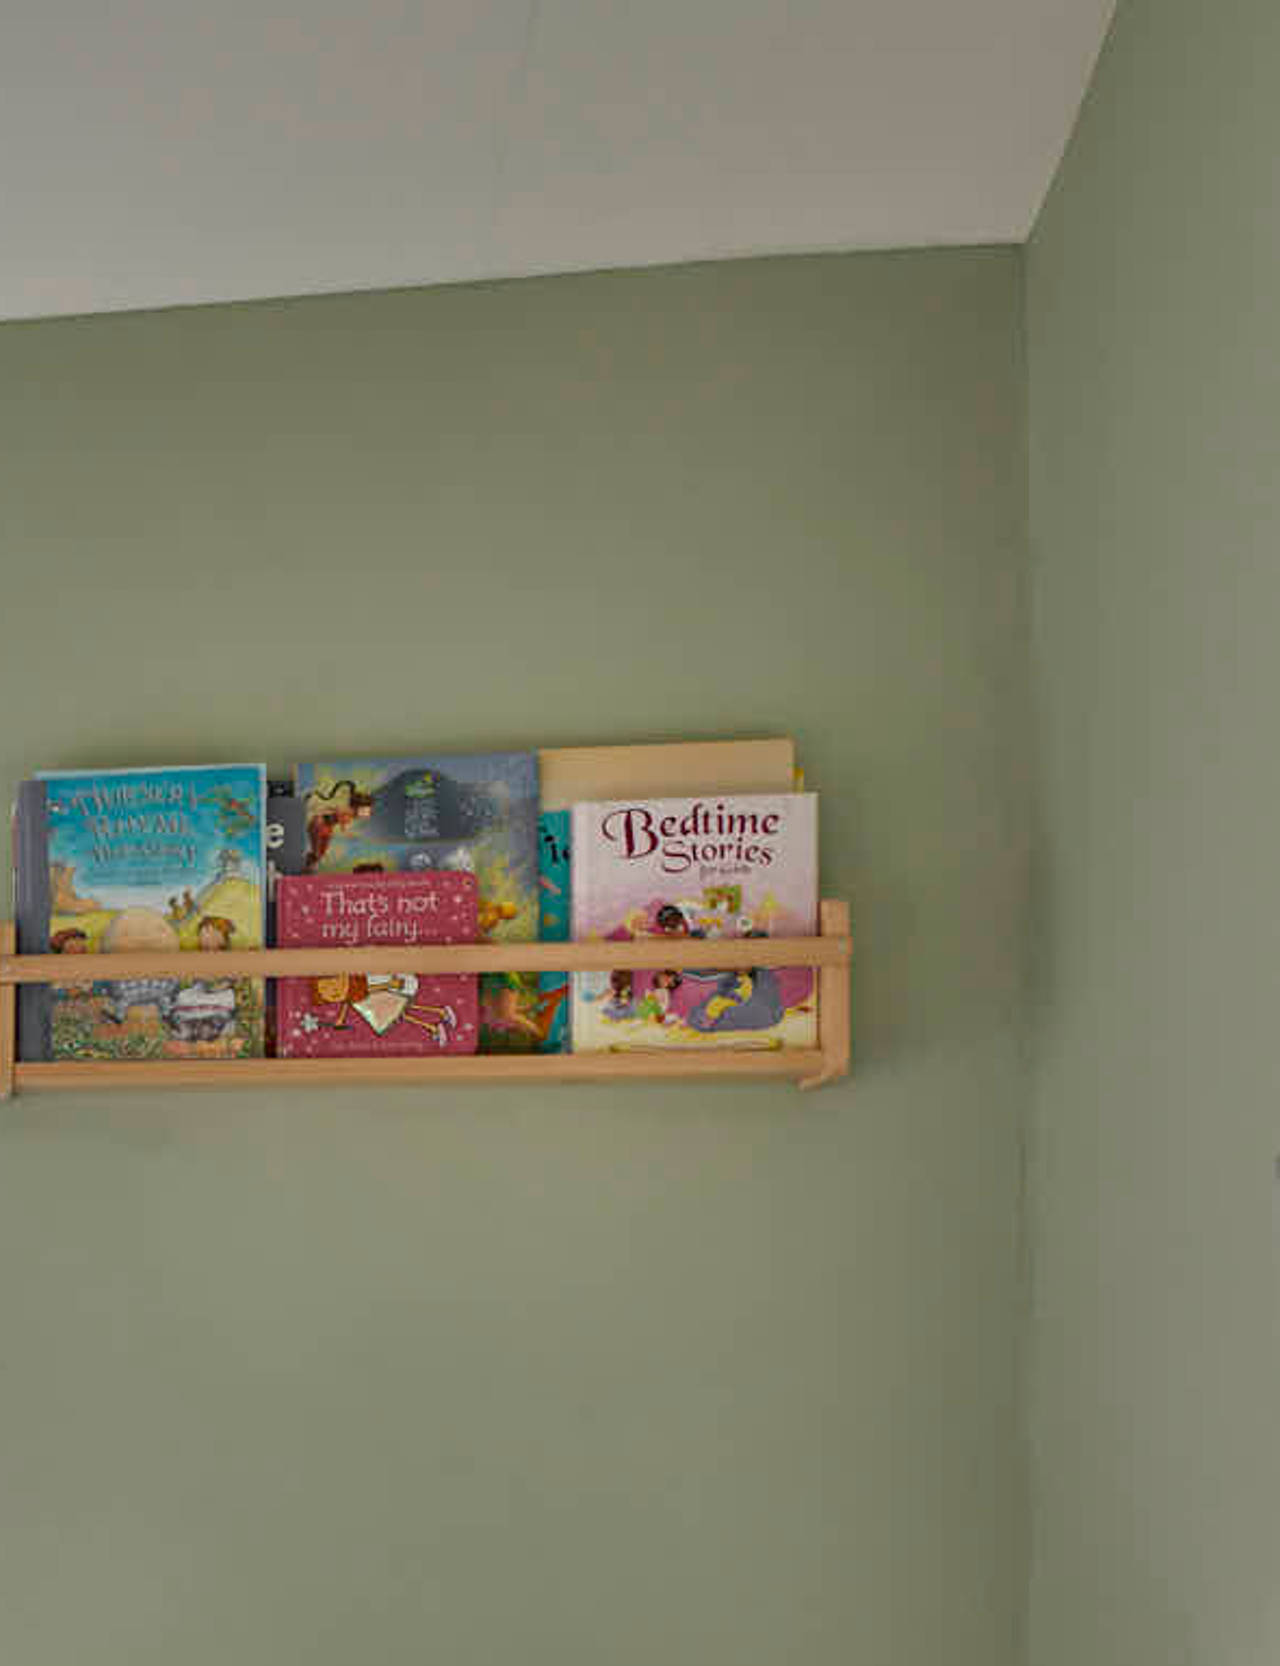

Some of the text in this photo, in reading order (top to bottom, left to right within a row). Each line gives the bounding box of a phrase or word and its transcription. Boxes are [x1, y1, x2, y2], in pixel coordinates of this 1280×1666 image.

[601, 802, 780, 859] Bedtime
[661, 837, 774, 874] Stories
[396, 890, 439, 914] not
[321, 919, 359, 945] my
